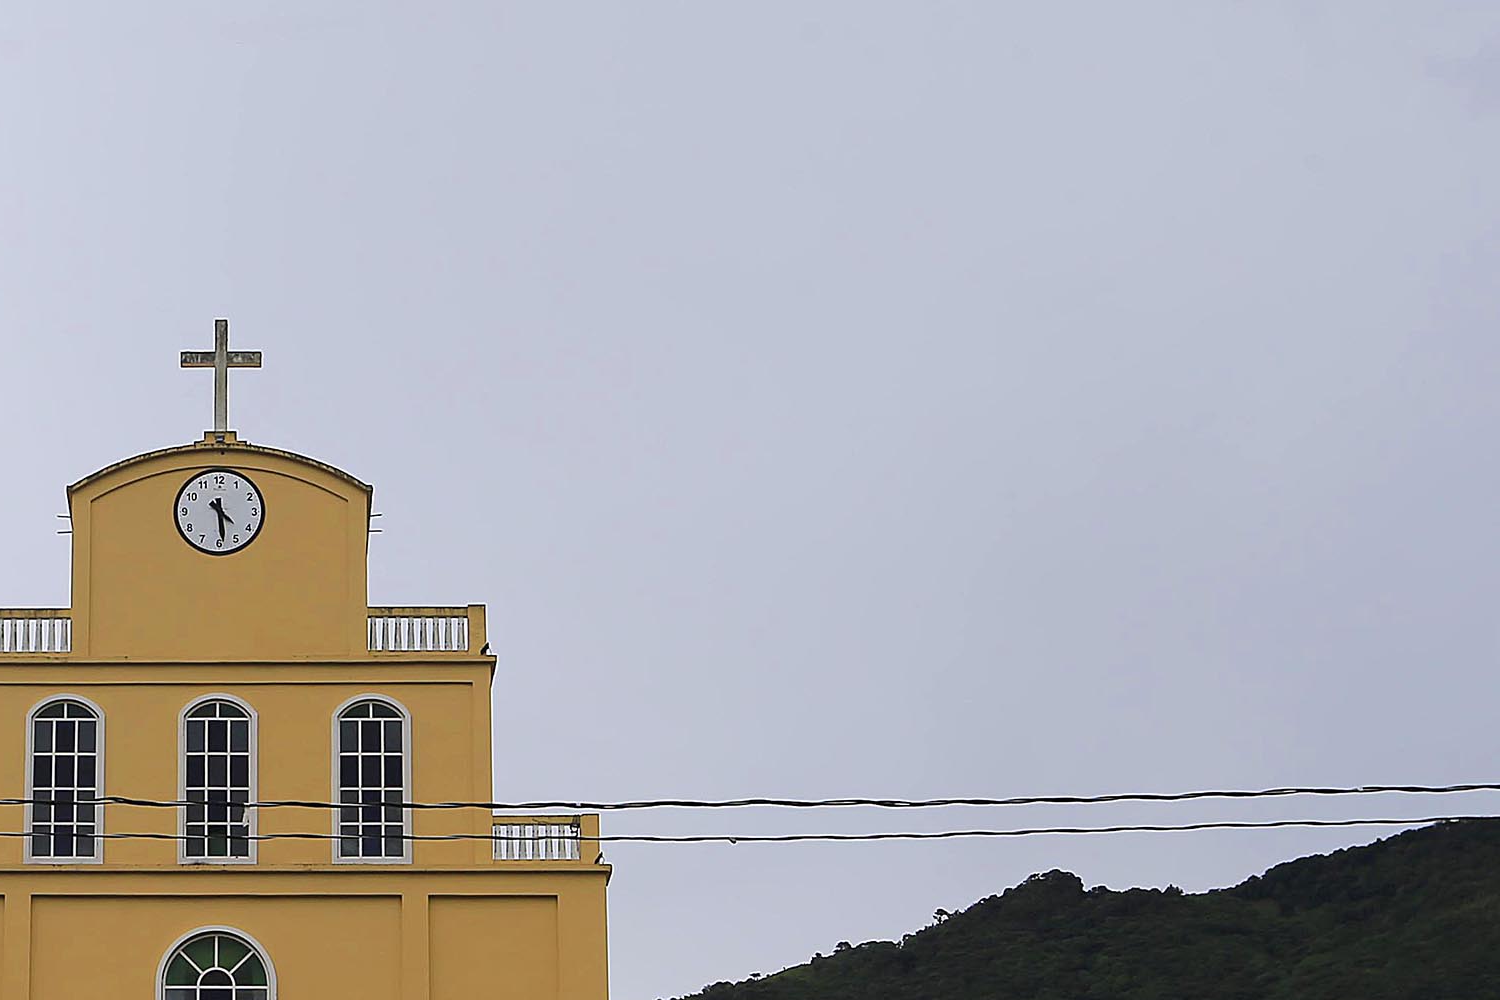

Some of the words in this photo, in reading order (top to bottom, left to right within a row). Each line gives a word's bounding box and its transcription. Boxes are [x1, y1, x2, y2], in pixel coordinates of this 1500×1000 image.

[198, 480, 208, 489] 11
[214, 476, 225, 485] 12
[233, 481, 239, 489] 1
[186, 492, 198, 501] 10
[246, 493, 253, 501] 2
[181, 507, 188, 516] 9
[251, 507, 258, 516] 3
[186, 523, 193, 532] 8
[245, 523, 252, 532] 4
[199, 534, 205, 543] 7
[233, 534, 239, 543] 5
[216, 539, 222, 548] 6
